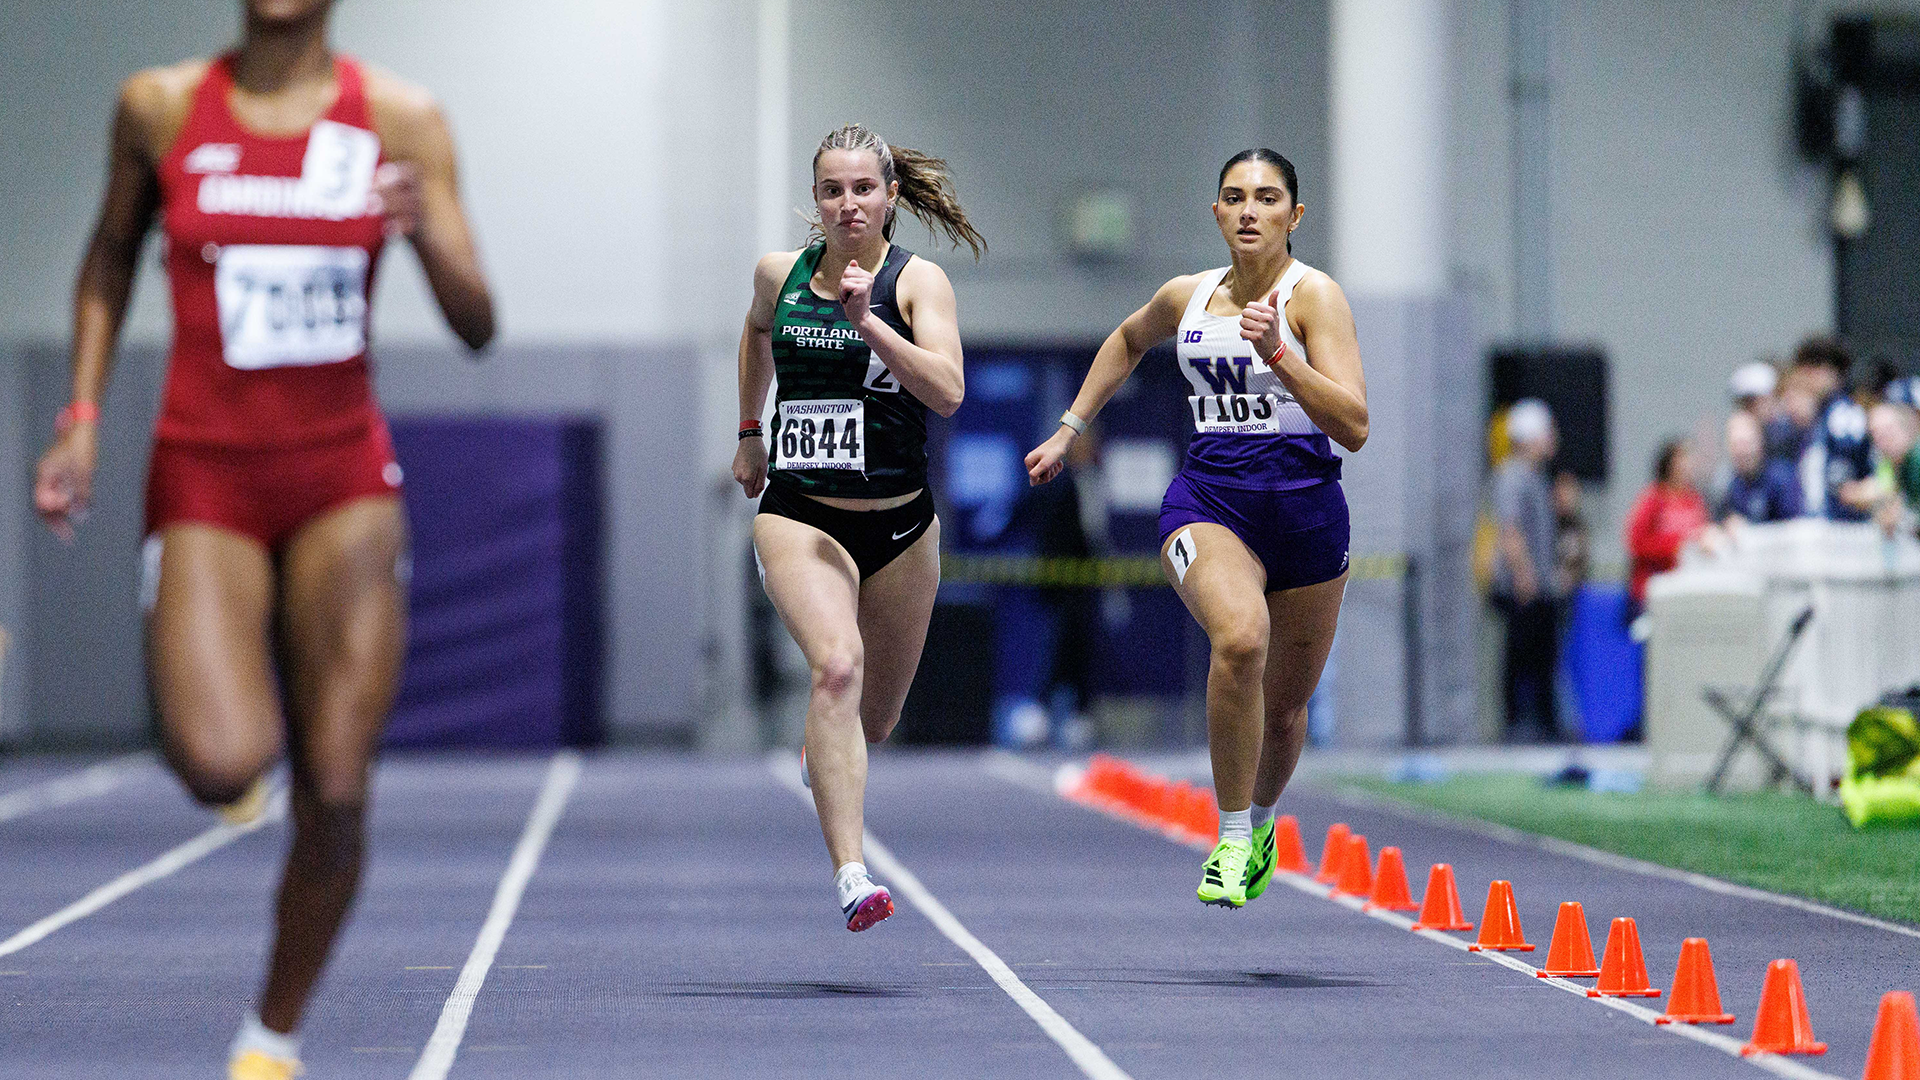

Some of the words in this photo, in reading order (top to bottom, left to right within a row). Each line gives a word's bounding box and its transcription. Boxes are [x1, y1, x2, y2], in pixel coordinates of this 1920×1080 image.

[796, 337, 845, 350] STATE
[1187, 356, 1253, 394] W
[786, 404, 853, 415] WASHINGTON
[1205, 425, 1235, 433] DEMPSEY
[1237, 423, 1268, 432] INDOOR
[782, 418, 860, 458] 6844
